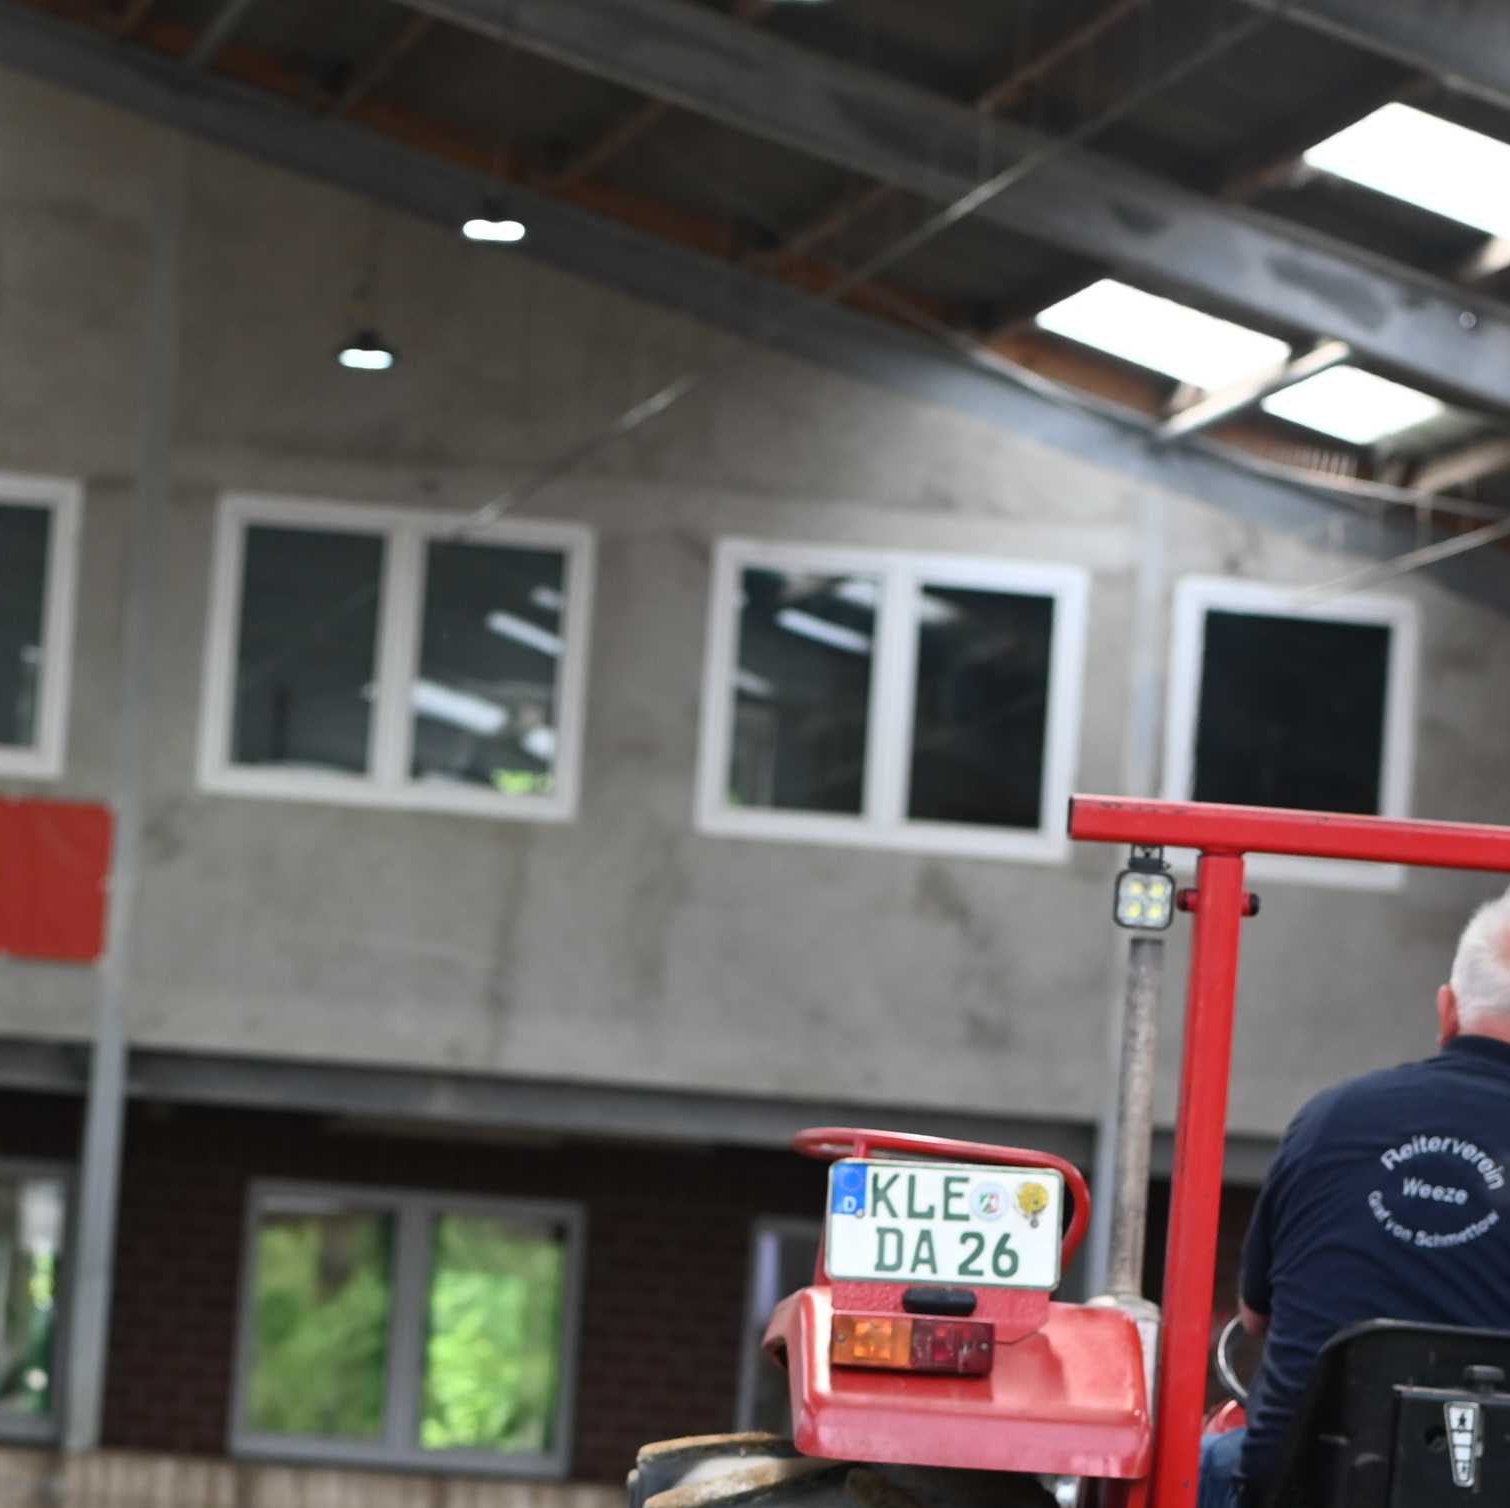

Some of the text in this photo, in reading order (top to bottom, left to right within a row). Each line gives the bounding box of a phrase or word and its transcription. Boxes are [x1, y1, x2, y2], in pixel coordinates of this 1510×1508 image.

[1380, 1134, 1505, 1190] Reiterverein
[842, 1196, 857, 1214] D
[871, 1172, 971, 1222] KLE
[1402, 1177, 1469, 1206] Weeze
[874, 1227, 1020, 1278] DA 26
